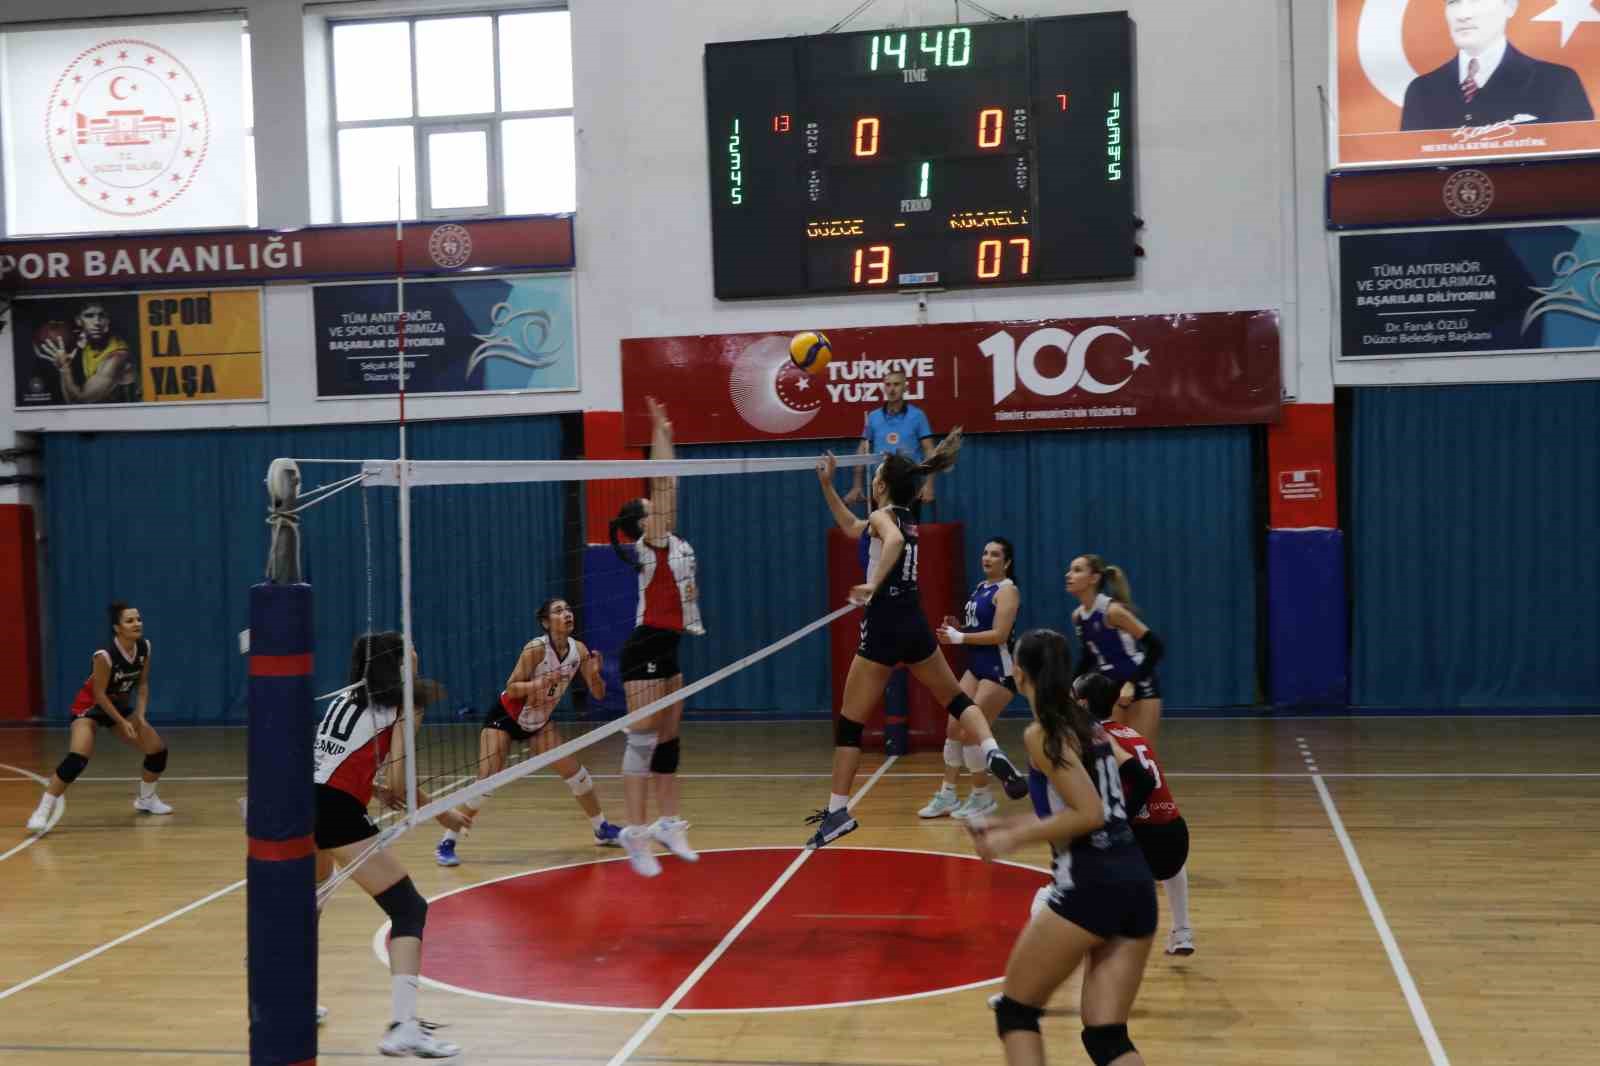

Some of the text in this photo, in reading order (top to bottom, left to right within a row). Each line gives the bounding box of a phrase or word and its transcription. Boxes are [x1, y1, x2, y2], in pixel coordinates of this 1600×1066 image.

[902, 68, 928, 83] TIME
[855, 118, 880, 156] 0
[979, 109, 1003, 148] 0
[919, 162, 930, 198] 1
[84, 235, 303, 276] BAKANLIĞI
[854, 245, 891, 284] 13
[977, 238, 1030, 278] 07
[1406, 260, 1481, 275] ANTRENÖR
[1357, 280, 1374, 291] VE
[147, 298, 213, 327] SPOR
[151, 330, 182, 358] LA
[150, 364, 217, 398] YAŞA
